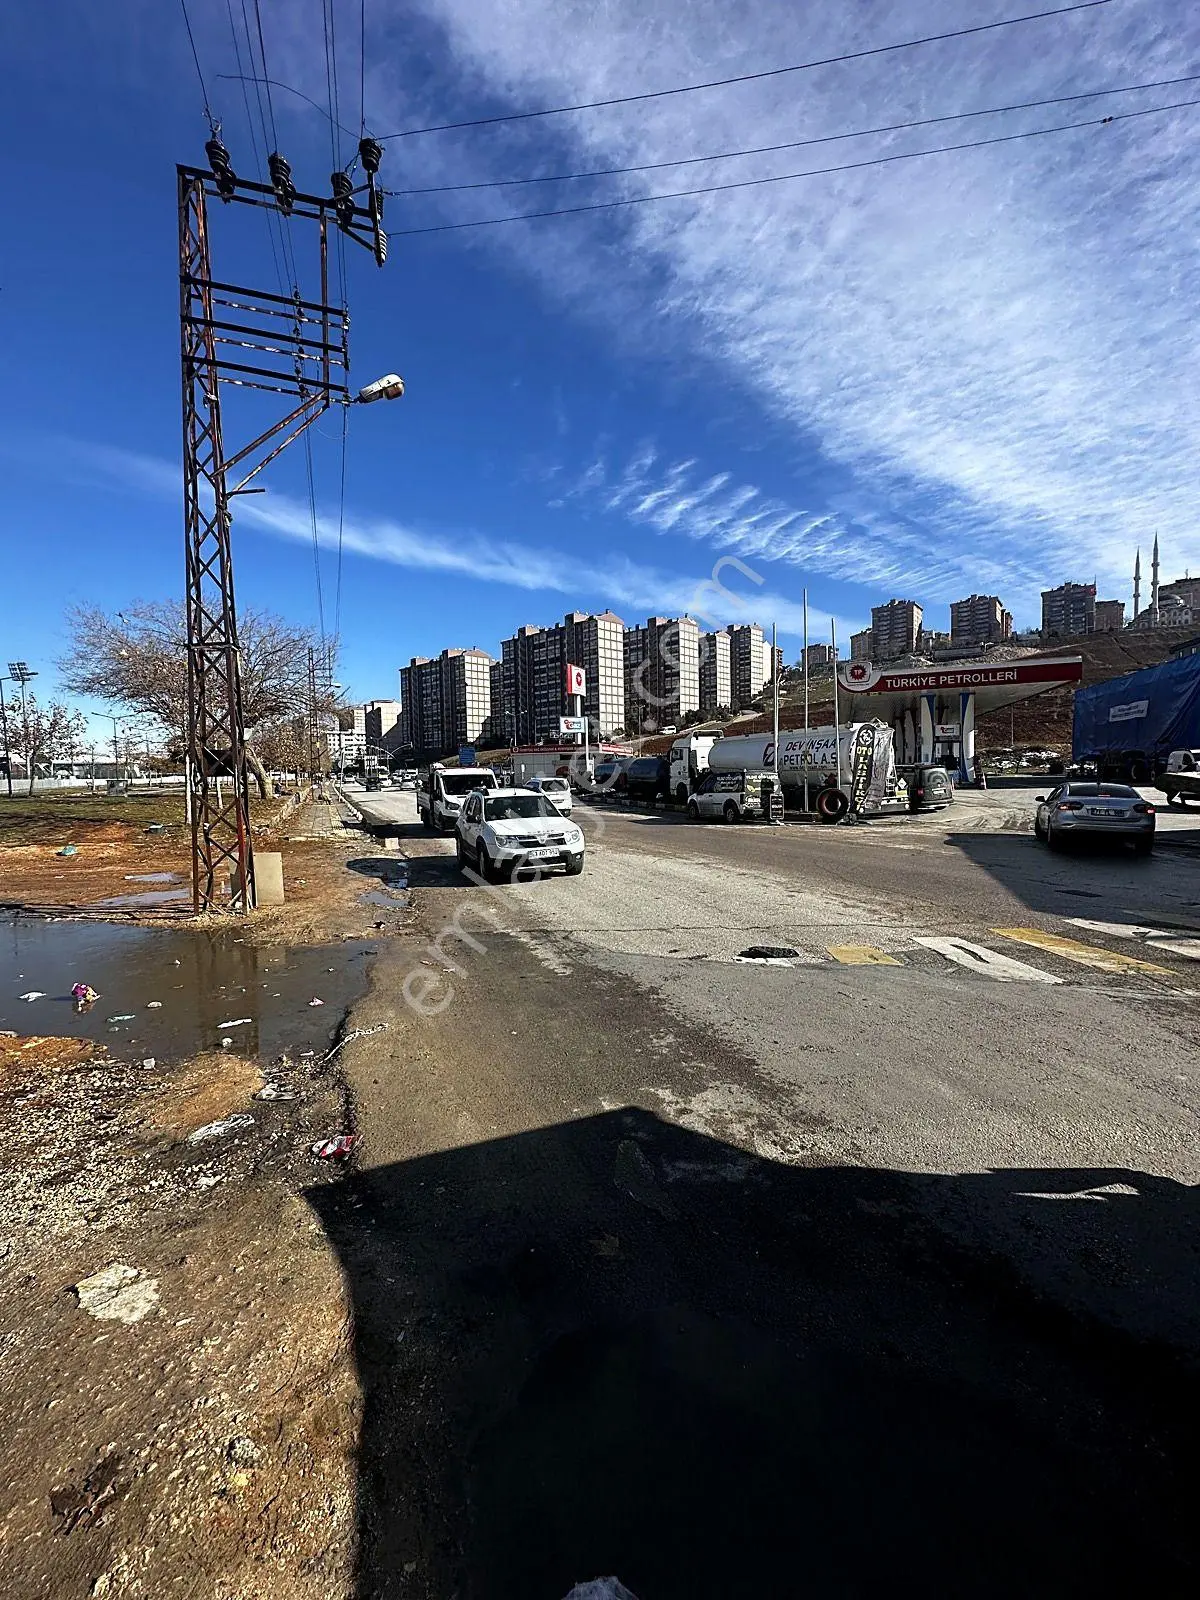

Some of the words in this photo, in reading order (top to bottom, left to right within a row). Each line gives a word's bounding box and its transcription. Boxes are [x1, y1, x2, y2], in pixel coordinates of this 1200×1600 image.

[886, 675, 936, 688] TÜRKİYE
[939, 669, 1018, 685] PETROLLERİ
[785, 739, 805, 752] DEV
[856, 746, 873, 756] OTO
[783, 753, 818, 766] PETROL
